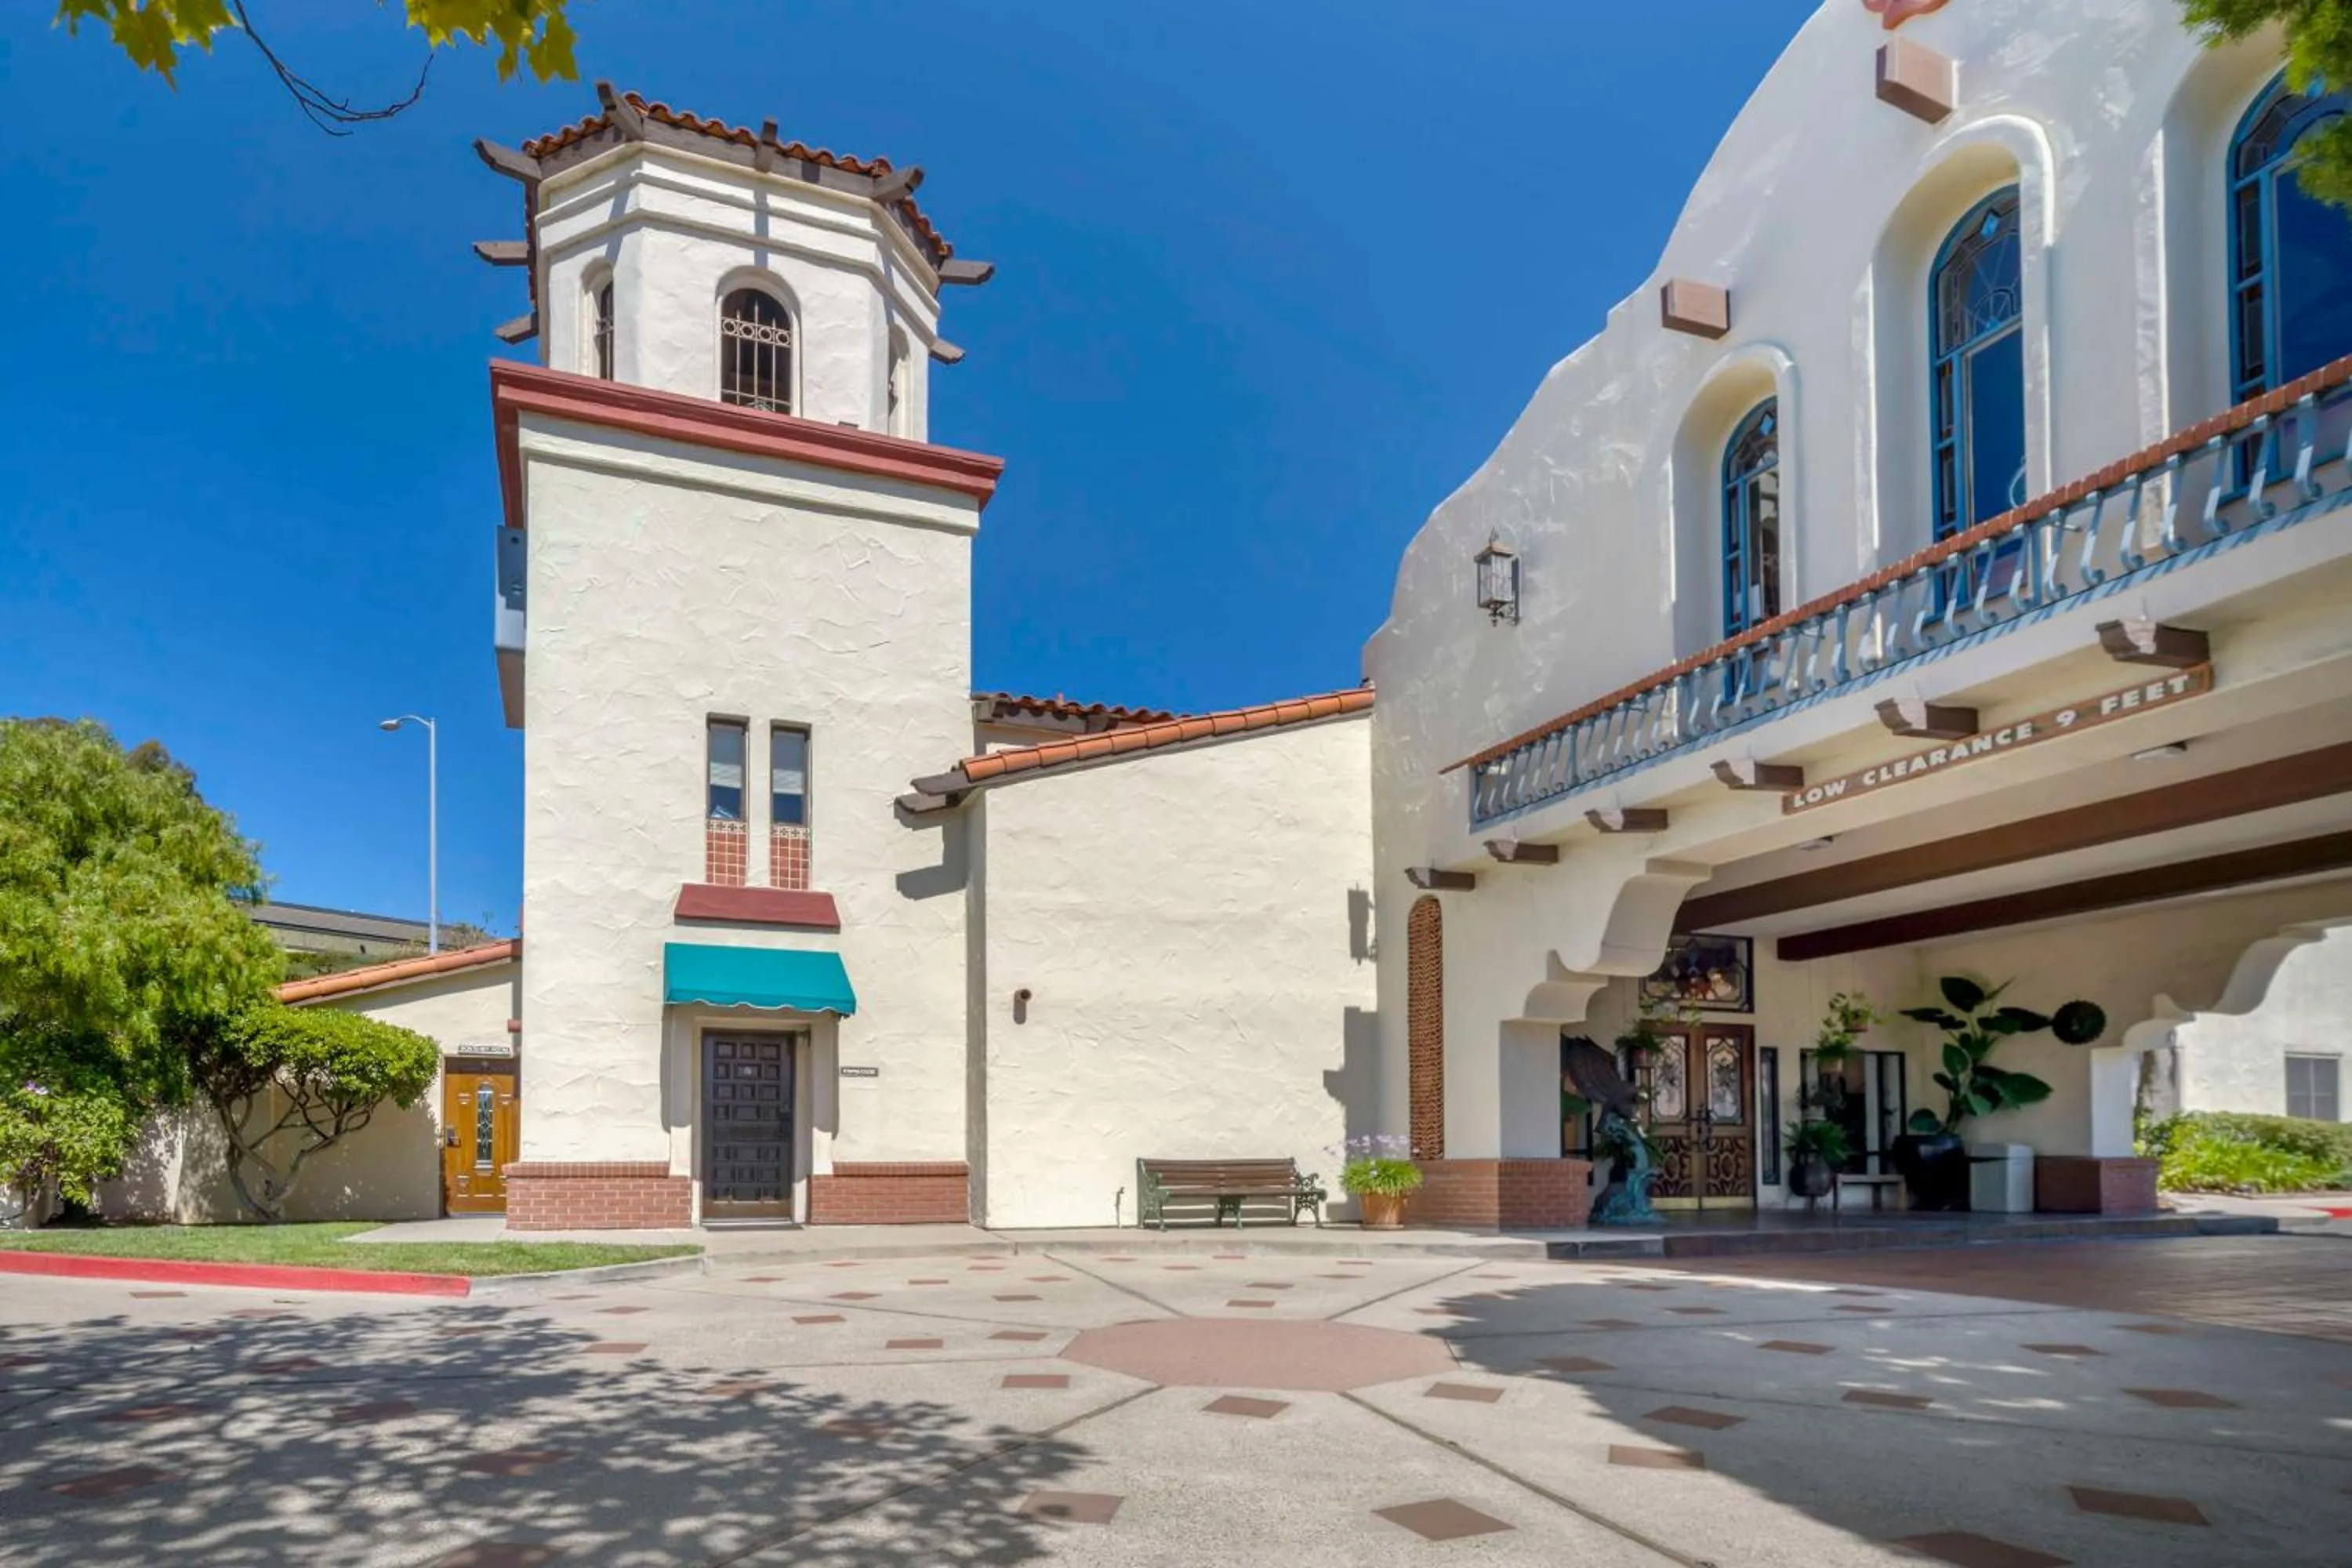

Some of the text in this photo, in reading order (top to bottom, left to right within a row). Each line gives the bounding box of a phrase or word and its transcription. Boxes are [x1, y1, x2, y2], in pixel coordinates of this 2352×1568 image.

[1793, 674, 2190, 807] LOW CLEARANCE 9 FEET
